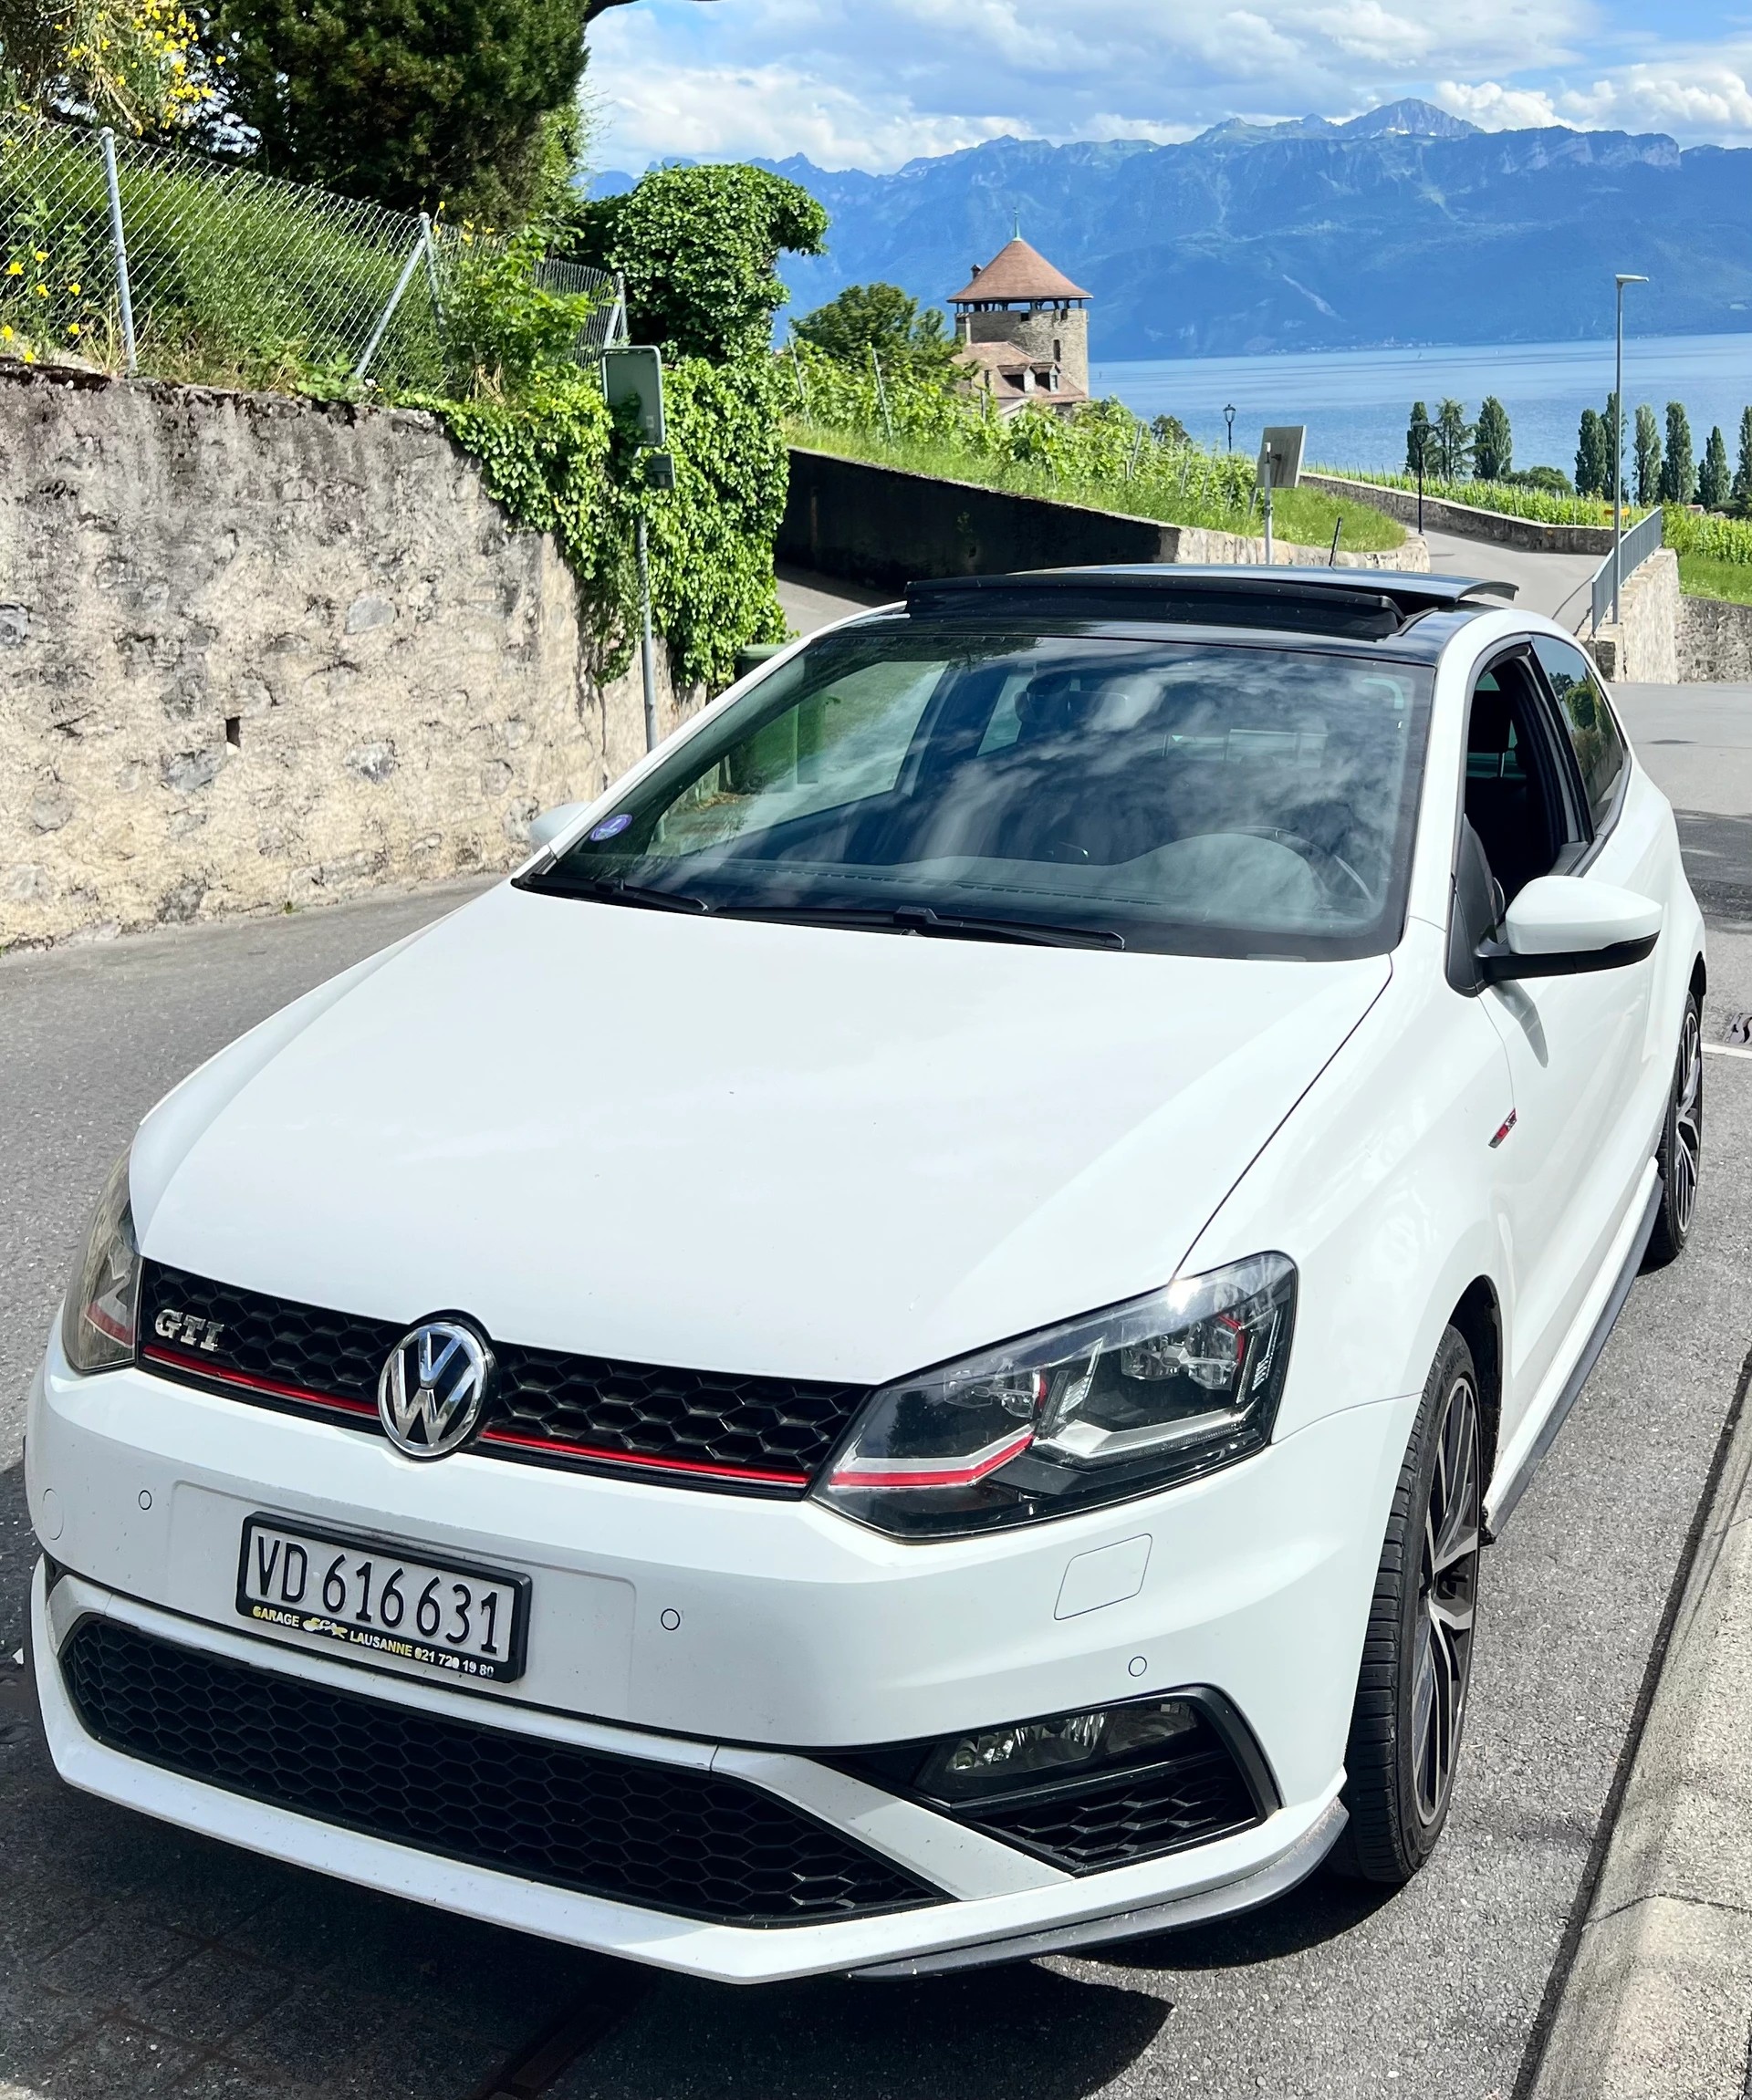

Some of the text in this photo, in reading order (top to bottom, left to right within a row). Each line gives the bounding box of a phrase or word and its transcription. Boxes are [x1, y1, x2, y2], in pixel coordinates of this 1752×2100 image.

[155, 1308, 224, 1352] GTI
[257, 1535, 308, 1603] VD
[253, 1606, 300, 1627] GARAGE
[349, 1630, 412, 1657] LAUSANNE
[462, 1659, 476, 1674] 19
